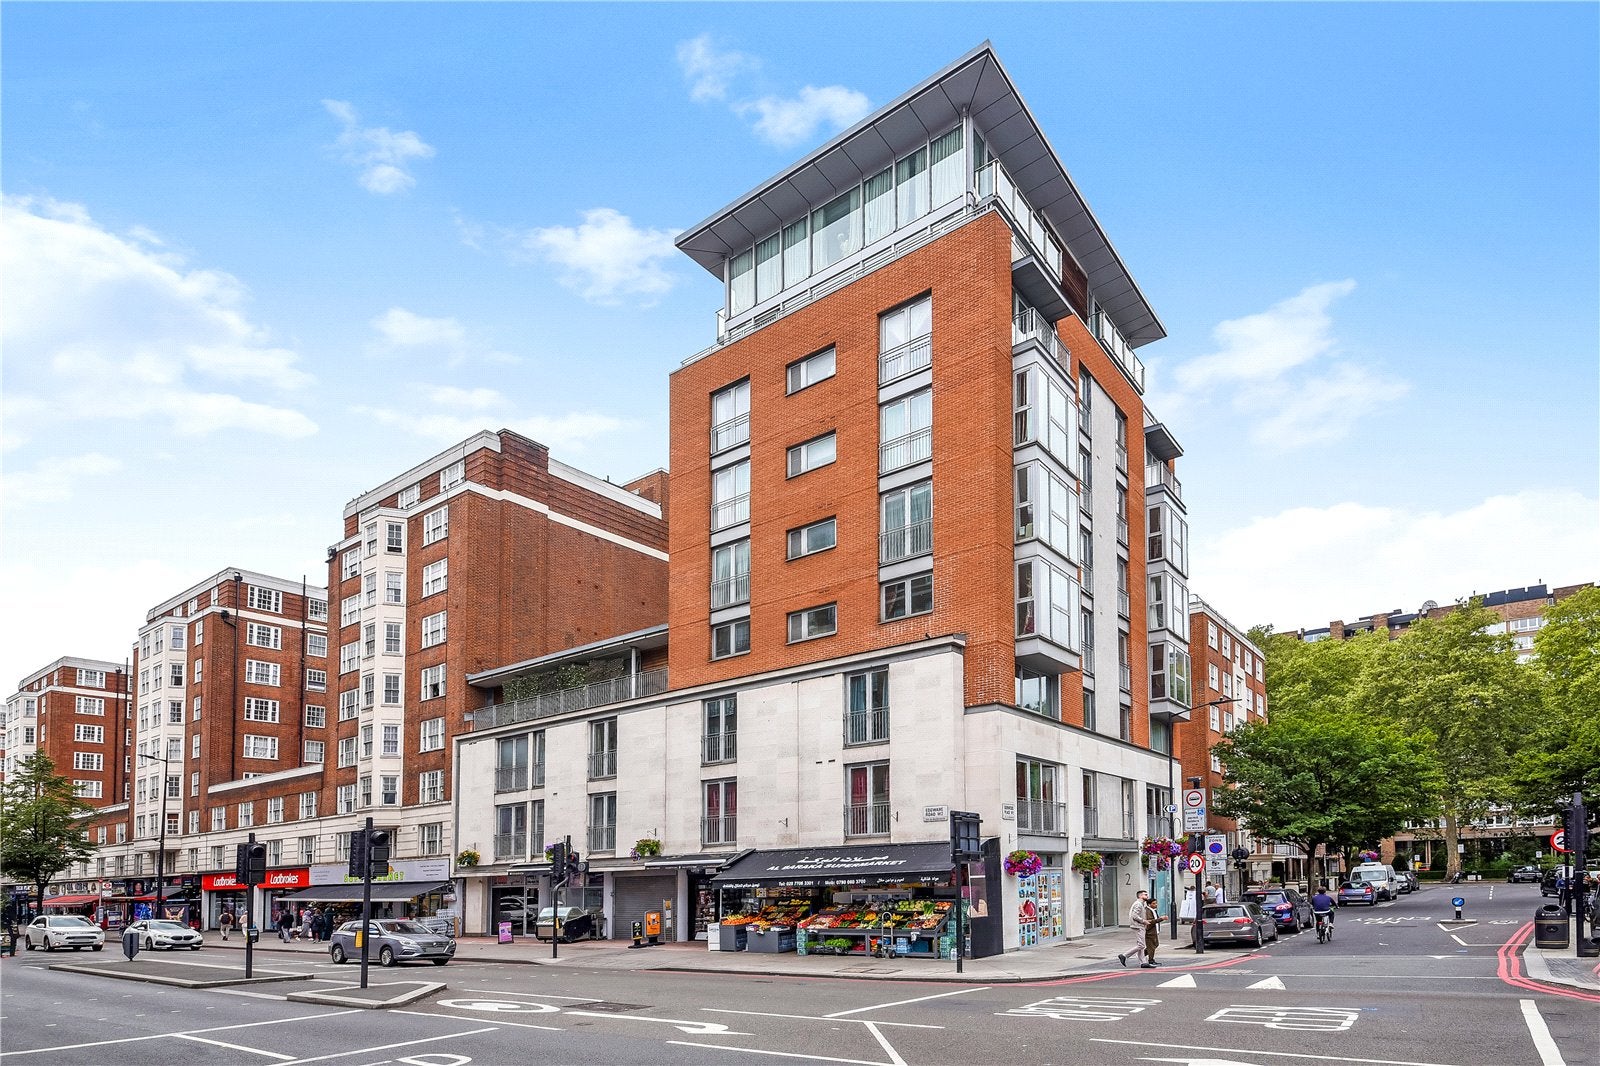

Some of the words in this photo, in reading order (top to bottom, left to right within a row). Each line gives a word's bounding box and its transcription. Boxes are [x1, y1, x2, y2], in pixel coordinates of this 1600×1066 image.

[823, 859, 907, 869] SUPERMARKET
[1190, 859, 1201, 868] 20
[270, 873, 298, 885] Ladbrokes
[1125, 873, 1131, 885] 2
[994, 996, 1162, 1021] CLEAR
[1204, 1004, 1362, 1031] KEEP
